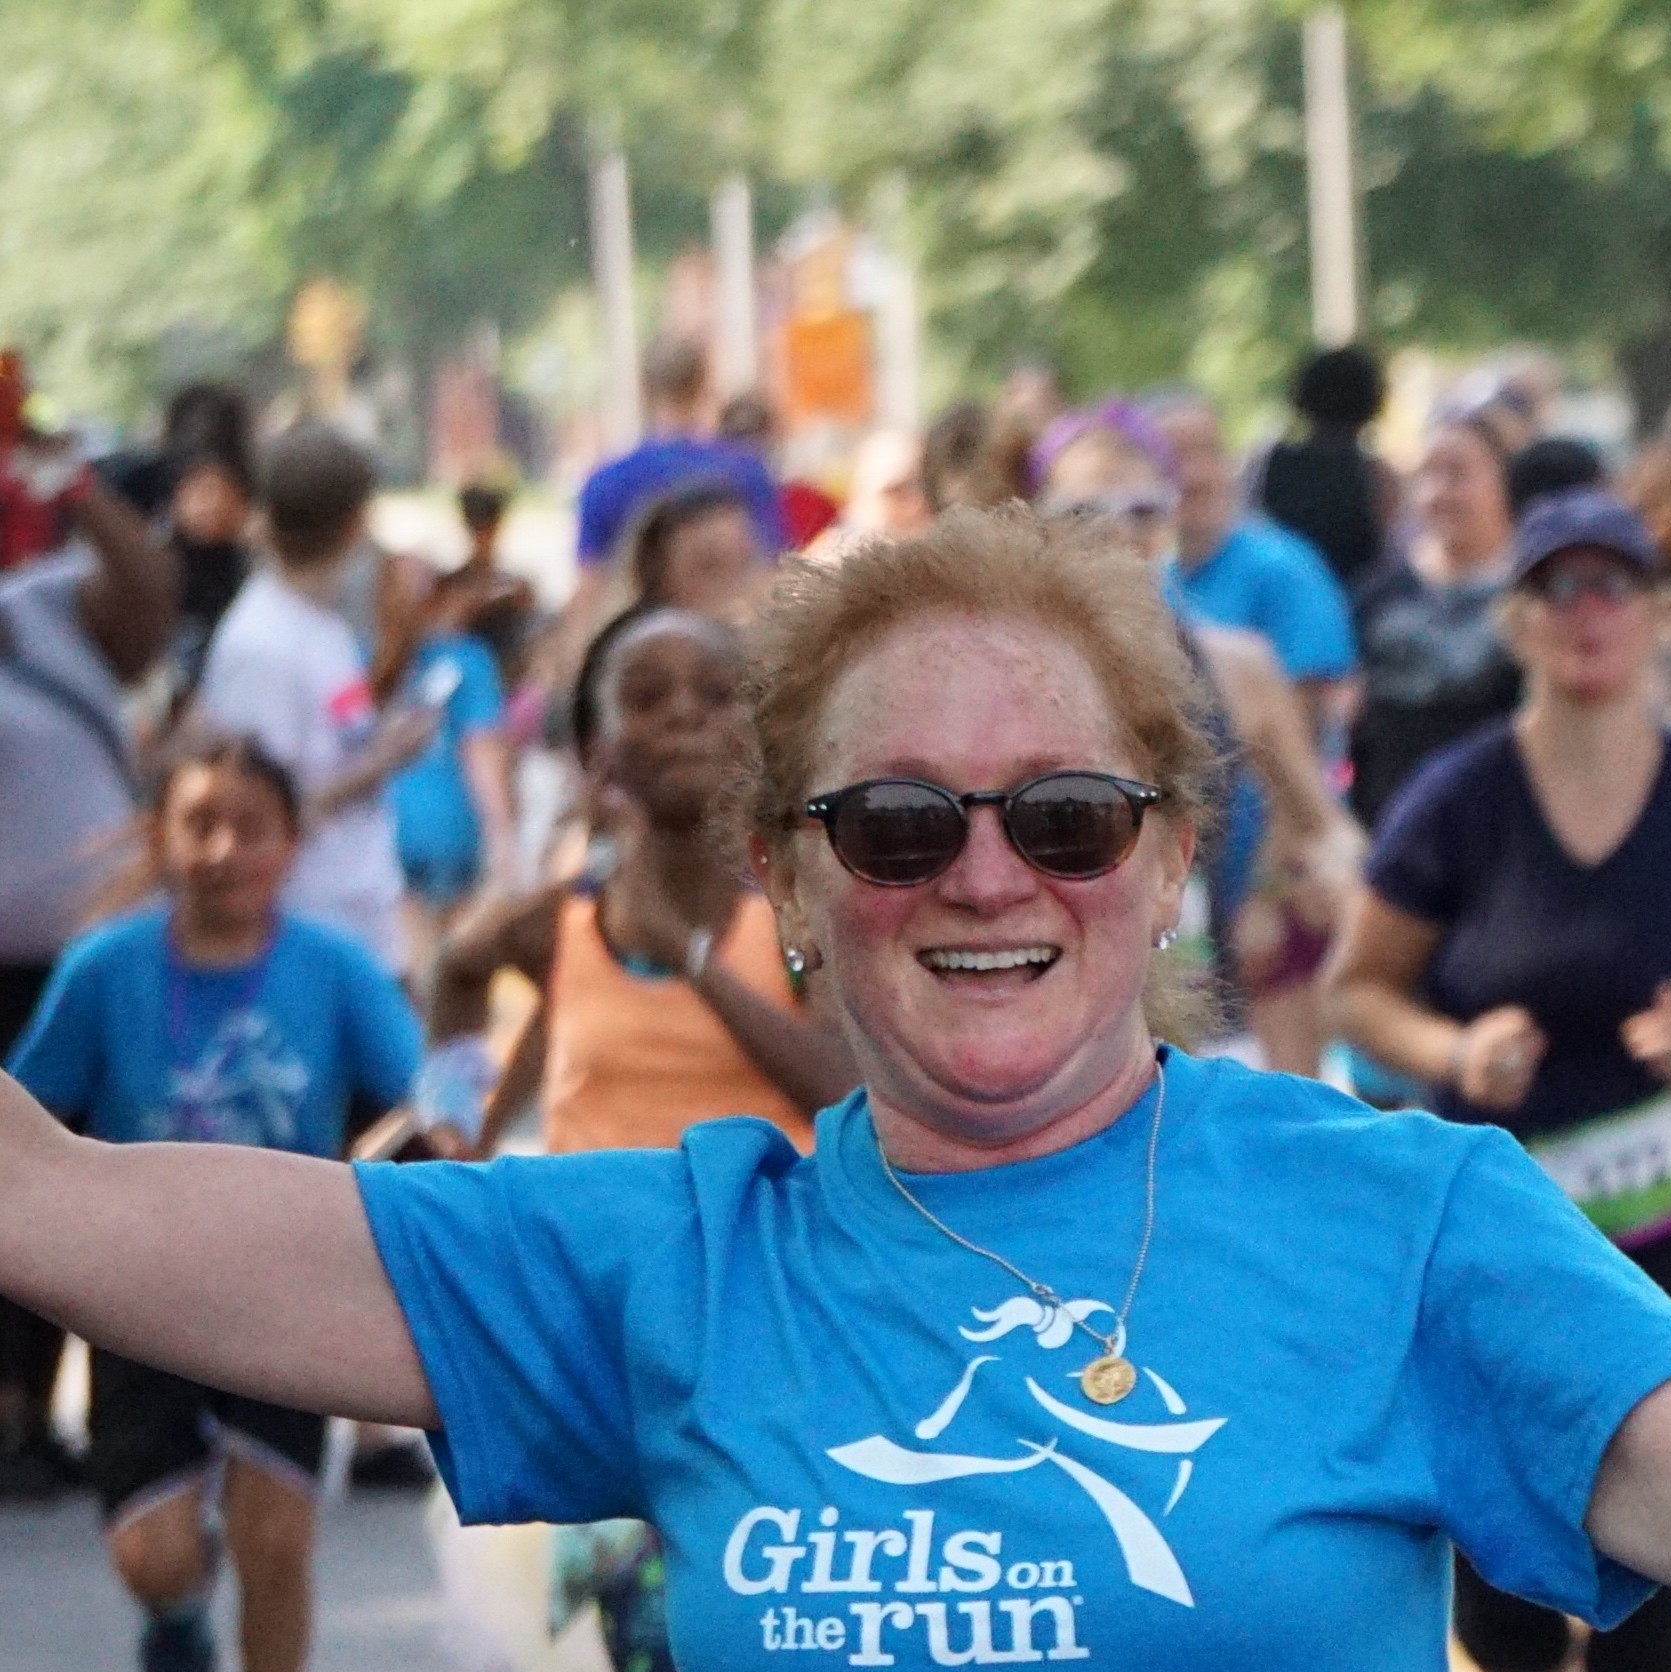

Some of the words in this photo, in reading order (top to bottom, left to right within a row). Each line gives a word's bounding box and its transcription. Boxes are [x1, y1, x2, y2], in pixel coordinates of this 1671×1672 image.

[723, 1506, 1002, 1595] Girls
[1007, 1559, 1077, 1589] on
[760, 1607, 847, 1651] the
[849, 1596, 1091, 1667] run
